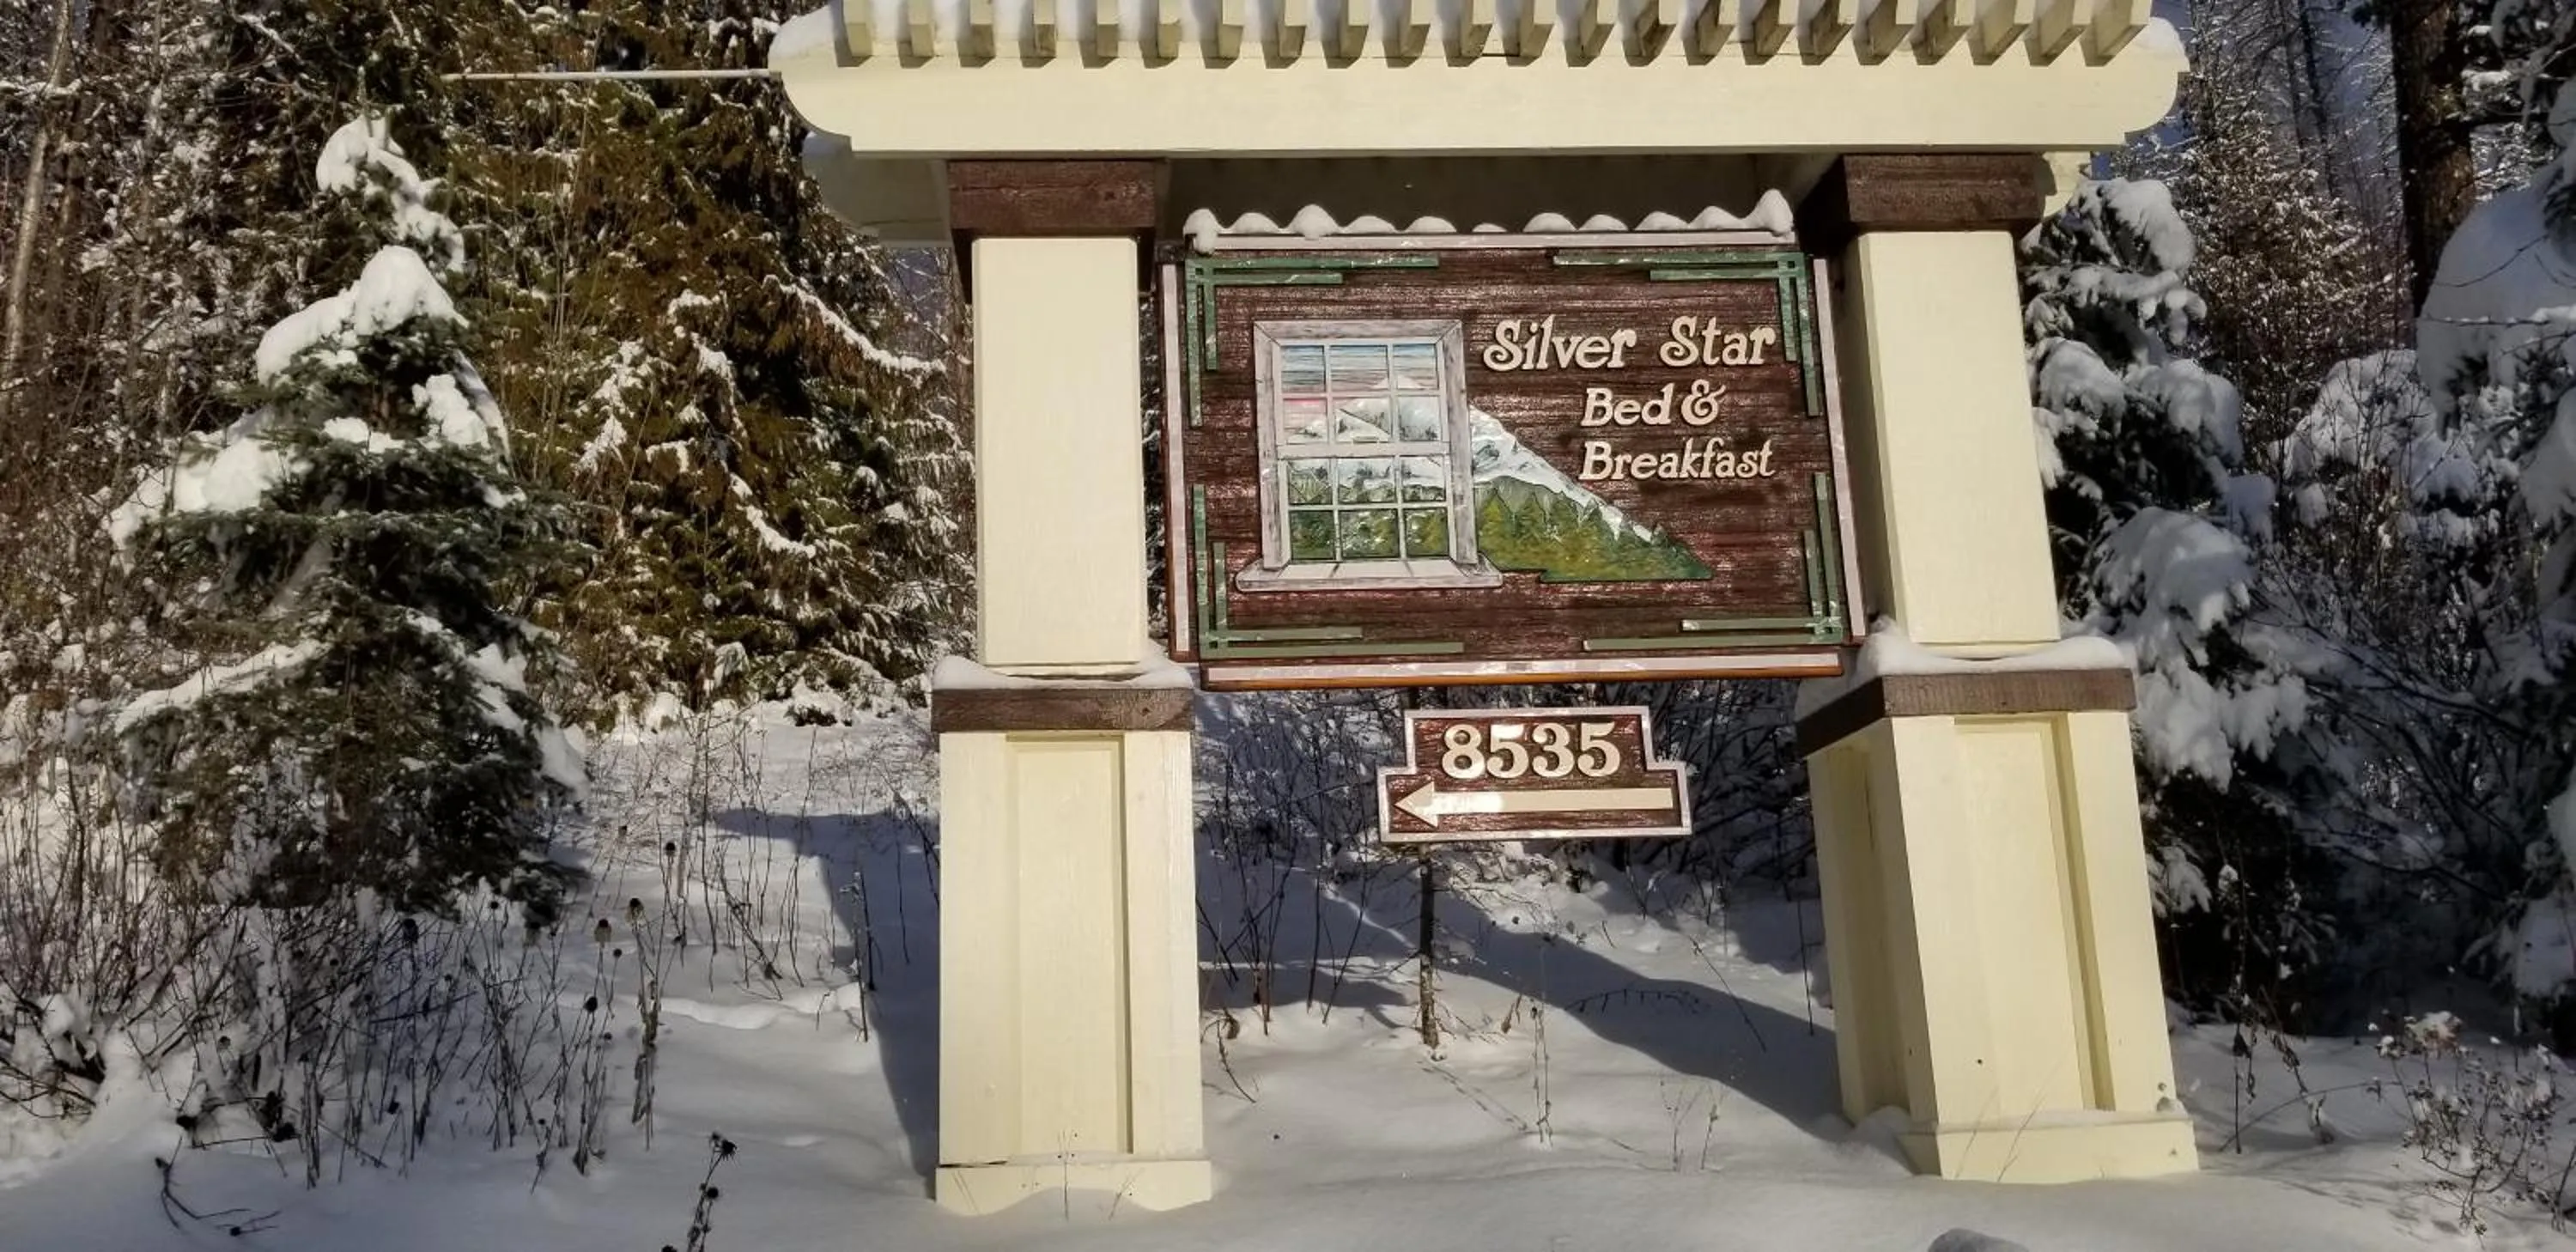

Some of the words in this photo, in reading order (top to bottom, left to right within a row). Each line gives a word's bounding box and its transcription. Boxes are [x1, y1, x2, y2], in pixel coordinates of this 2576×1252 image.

[1482, 314, 1637, 372] Silver
[1660, 315, 1777, 367] Star
[1581, 382, 1675, 427] Bed
[1680, 379, 1727, 426] &
[1578, 438, 1777, 481] Breakfast
[1441, 722, 1620, 779] 8535
